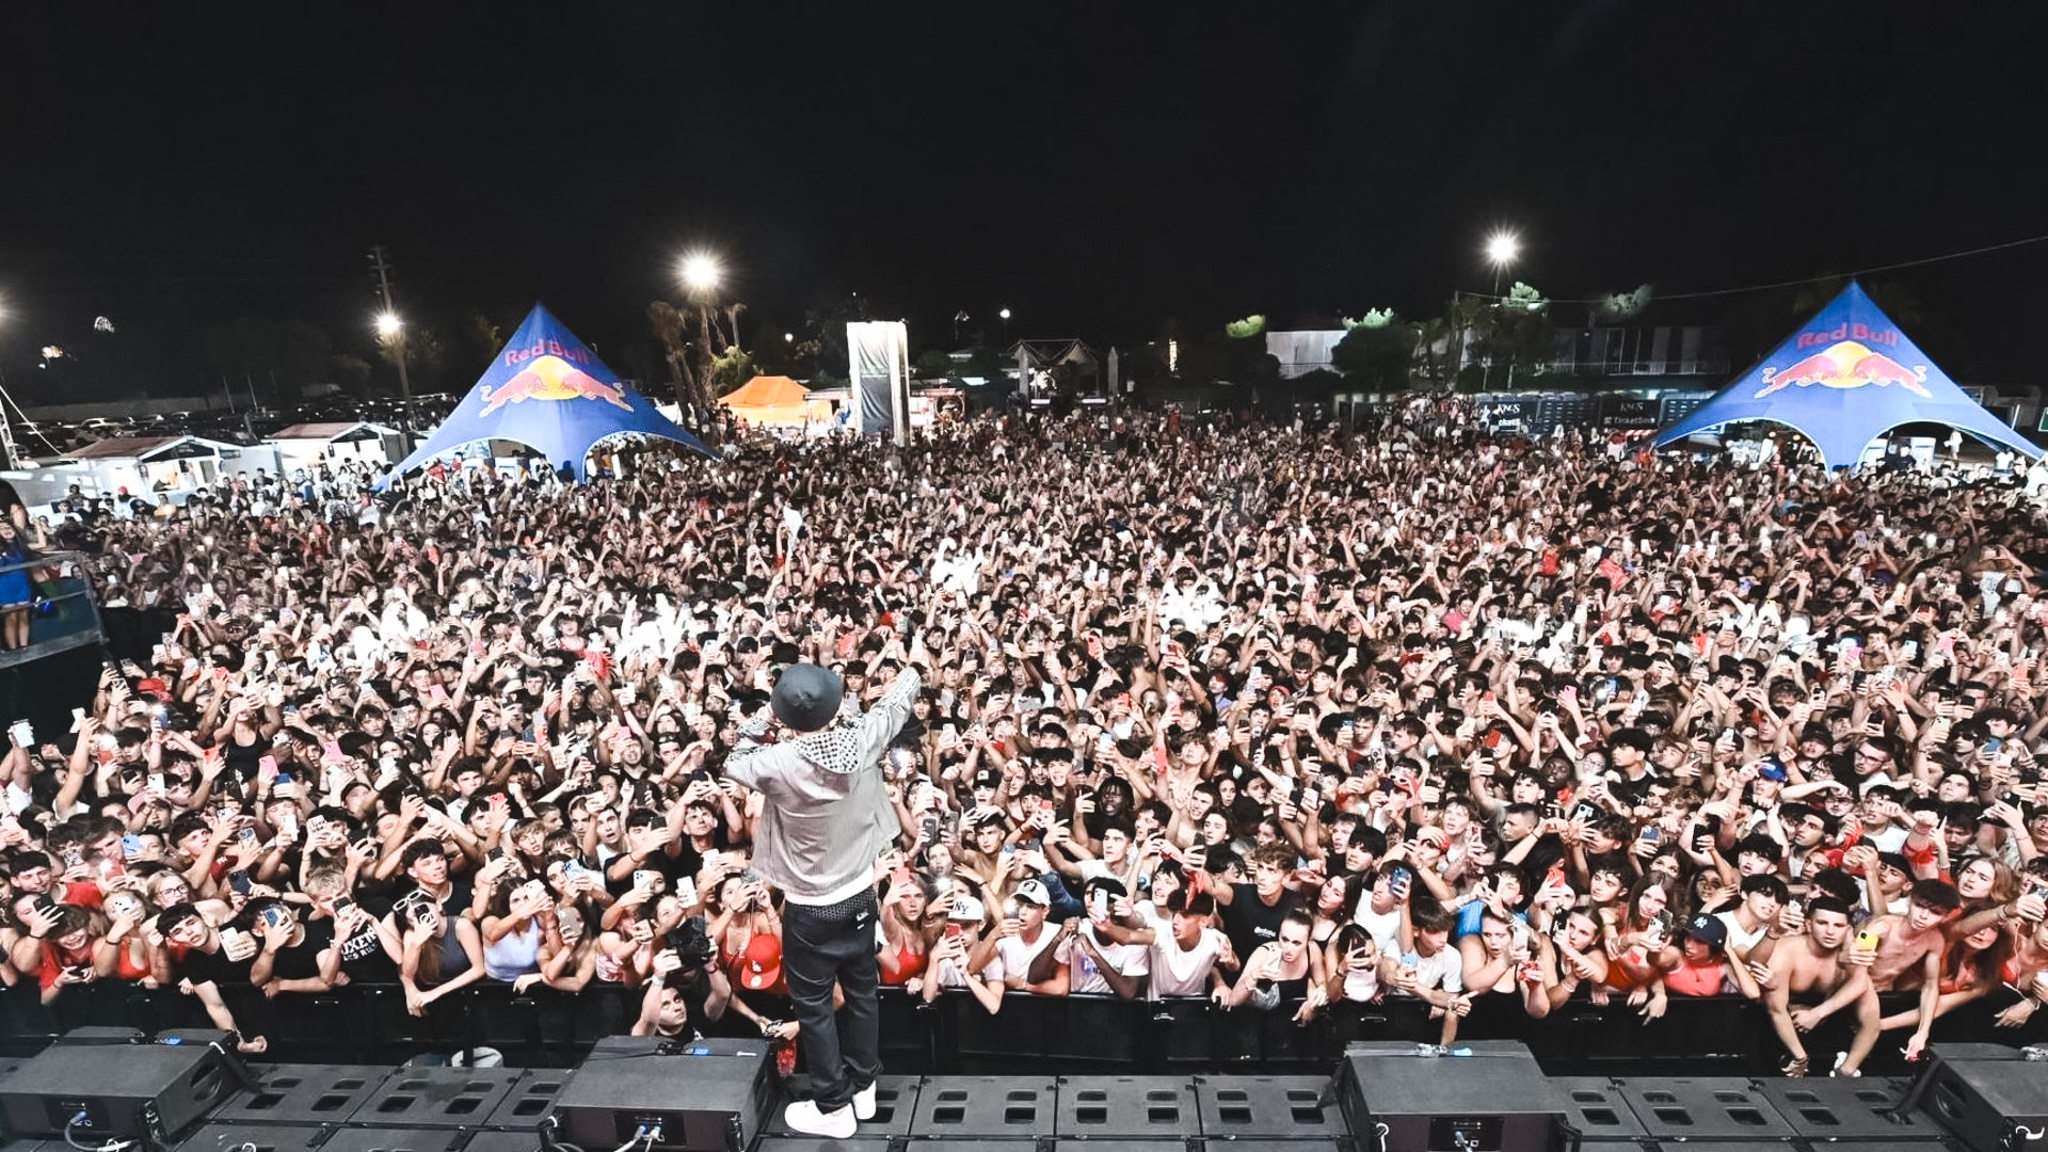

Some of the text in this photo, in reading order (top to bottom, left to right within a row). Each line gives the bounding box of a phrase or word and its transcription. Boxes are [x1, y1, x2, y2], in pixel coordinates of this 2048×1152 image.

[1797, 322, 1898, 349] Red Bull
[505, 338, 589, 366] Red Bull
